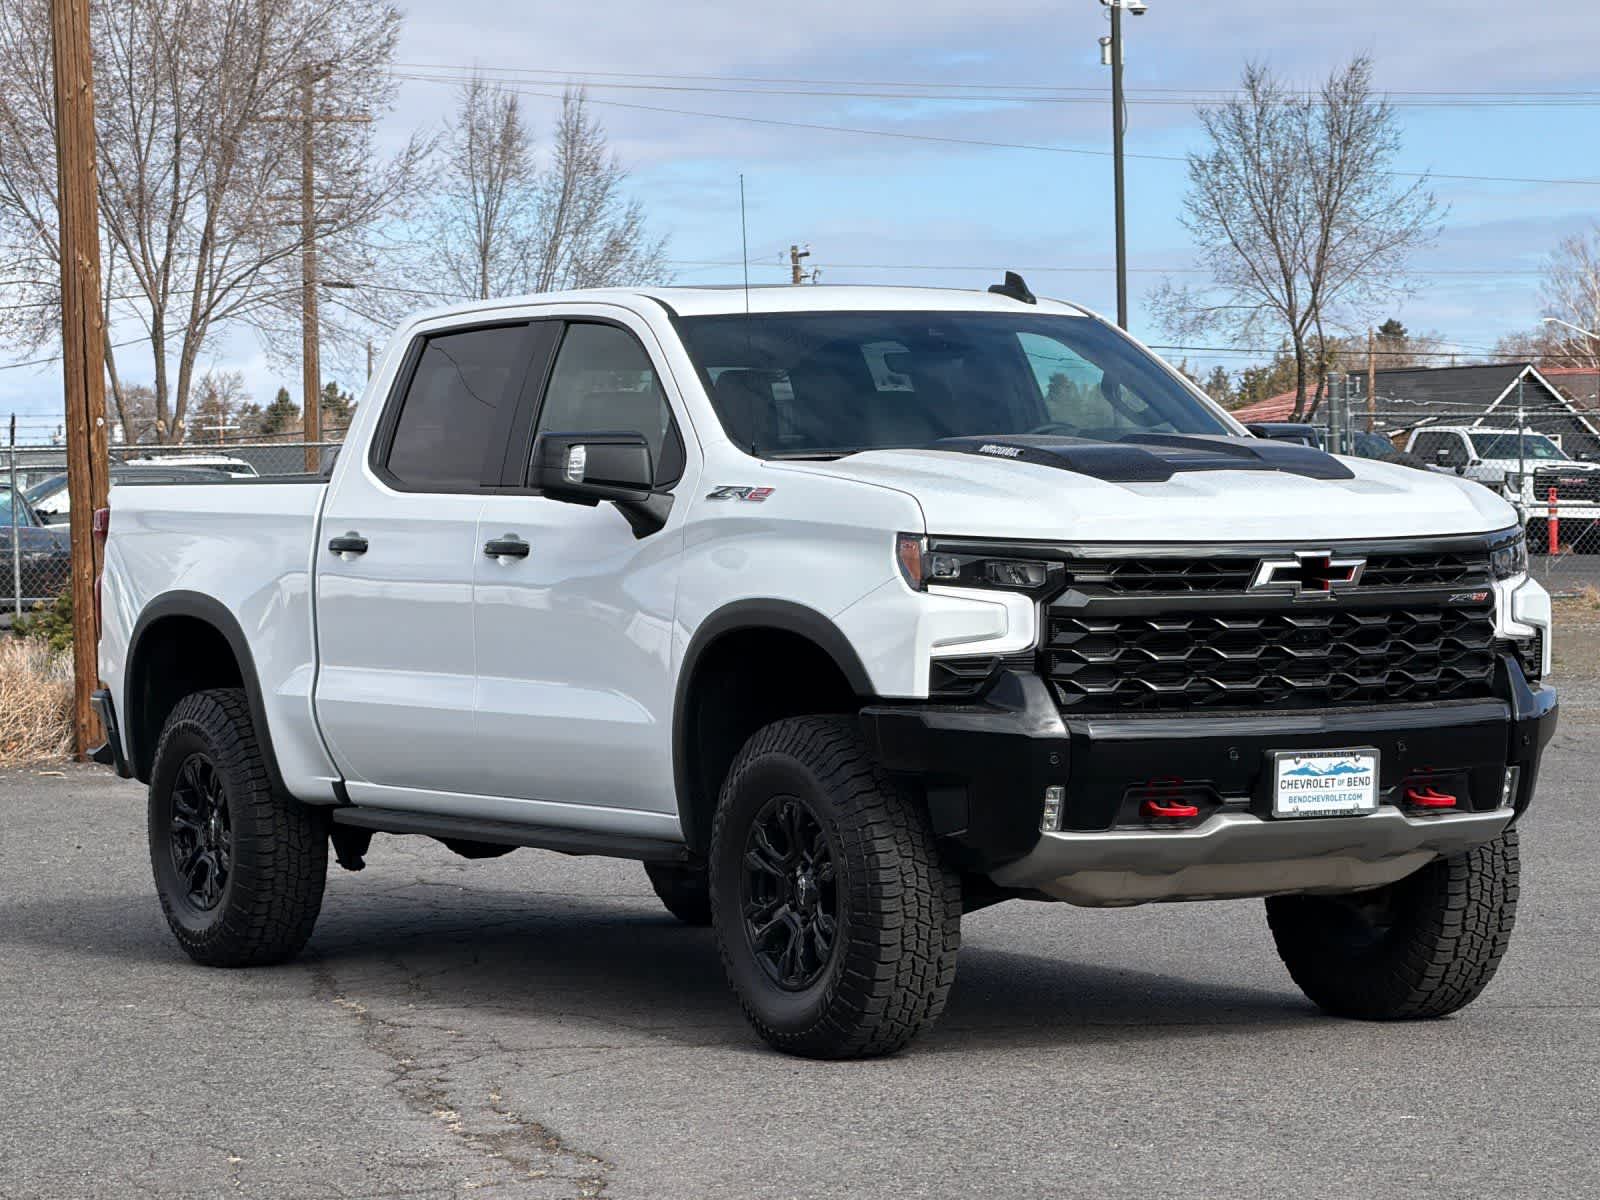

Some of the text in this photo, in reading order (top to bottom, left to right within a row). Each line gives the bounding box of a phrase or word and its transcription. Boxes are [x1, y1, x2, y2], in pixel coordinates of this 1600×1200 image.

[705, 485, 776, 502] ZR2
[1280, 778, 1336, 790] CHEVROLET
[1347, 776, 1371, 787] BEND
[1288, 793, 1363, 804] BENDCHEVROLET.COM
